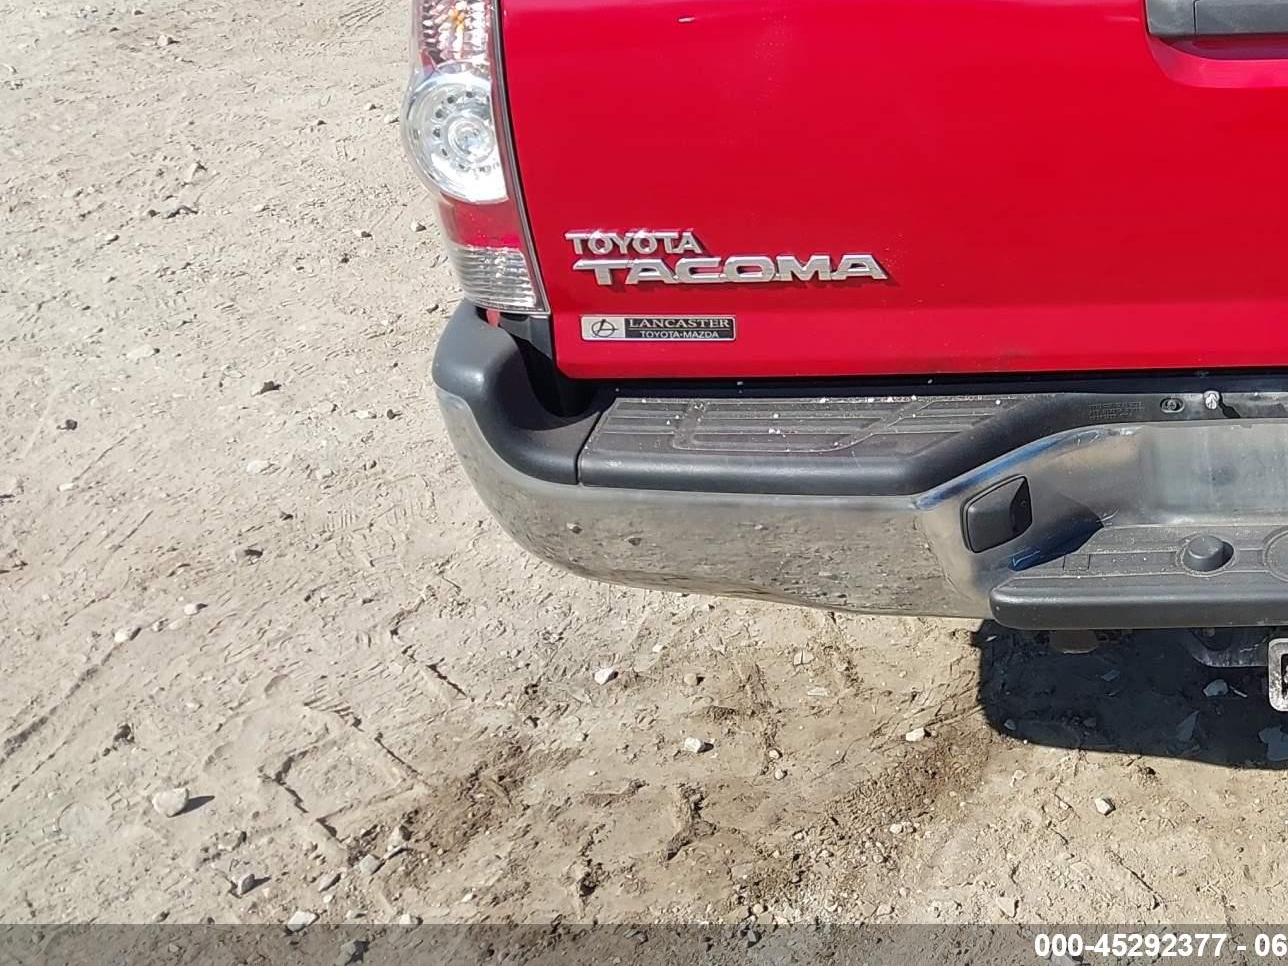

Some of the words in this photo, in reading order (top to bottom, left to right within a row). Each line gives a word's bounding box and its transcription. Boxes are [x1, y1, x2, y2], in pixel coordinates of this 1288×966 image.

[565, 229, 702, 254] TOYOTA
[573, 254, 888, 285] TACOMA
[629, 318, 730, 328] LANCASTER
